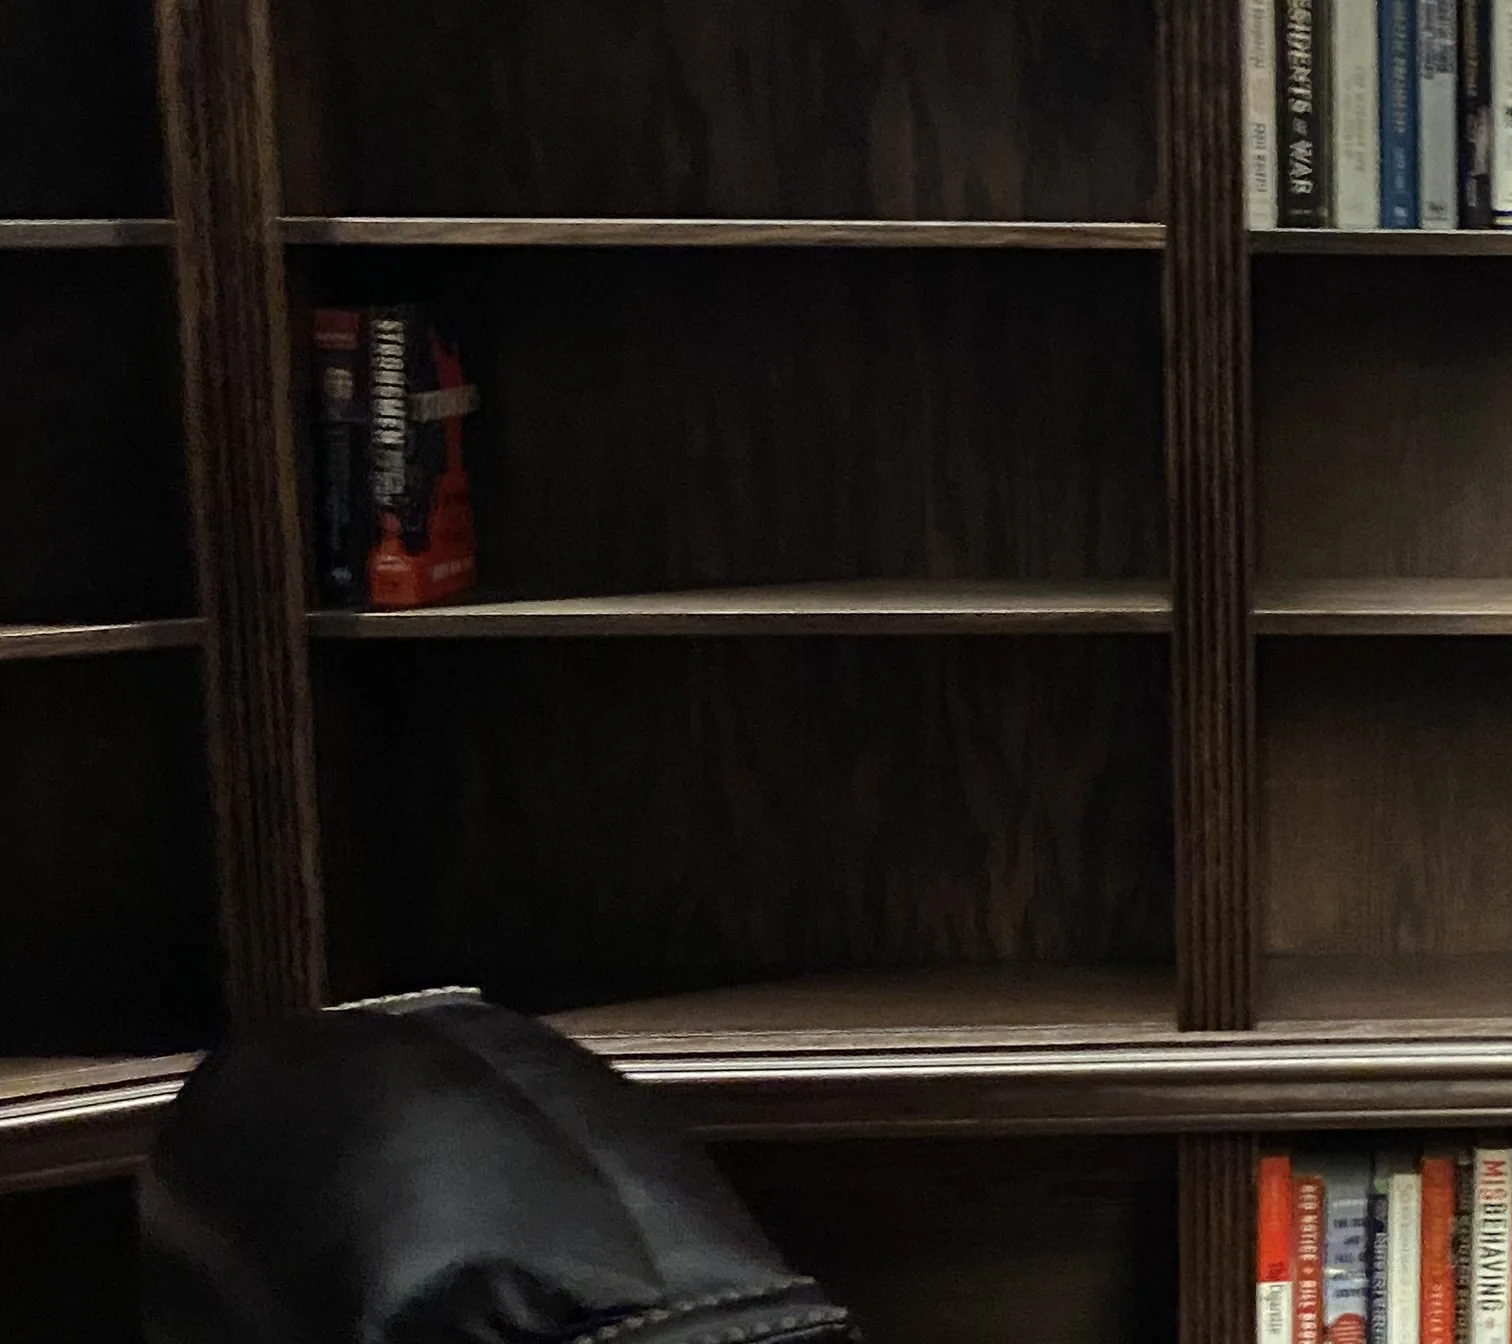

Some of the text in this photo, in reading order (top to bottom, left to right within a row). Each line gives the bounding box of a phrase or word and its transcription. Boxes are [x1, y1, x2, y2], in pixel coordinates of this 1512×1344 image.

[1288, 139, 1313, 195] WAR
[1299, 1184, 1319, 1210] RED
[1299, 1215, 1319, 1262] NOTICE
[1477, 1159, 1507, 1312] MISBEHAVING
[1299, 1280, 1318, 1309] BILL
